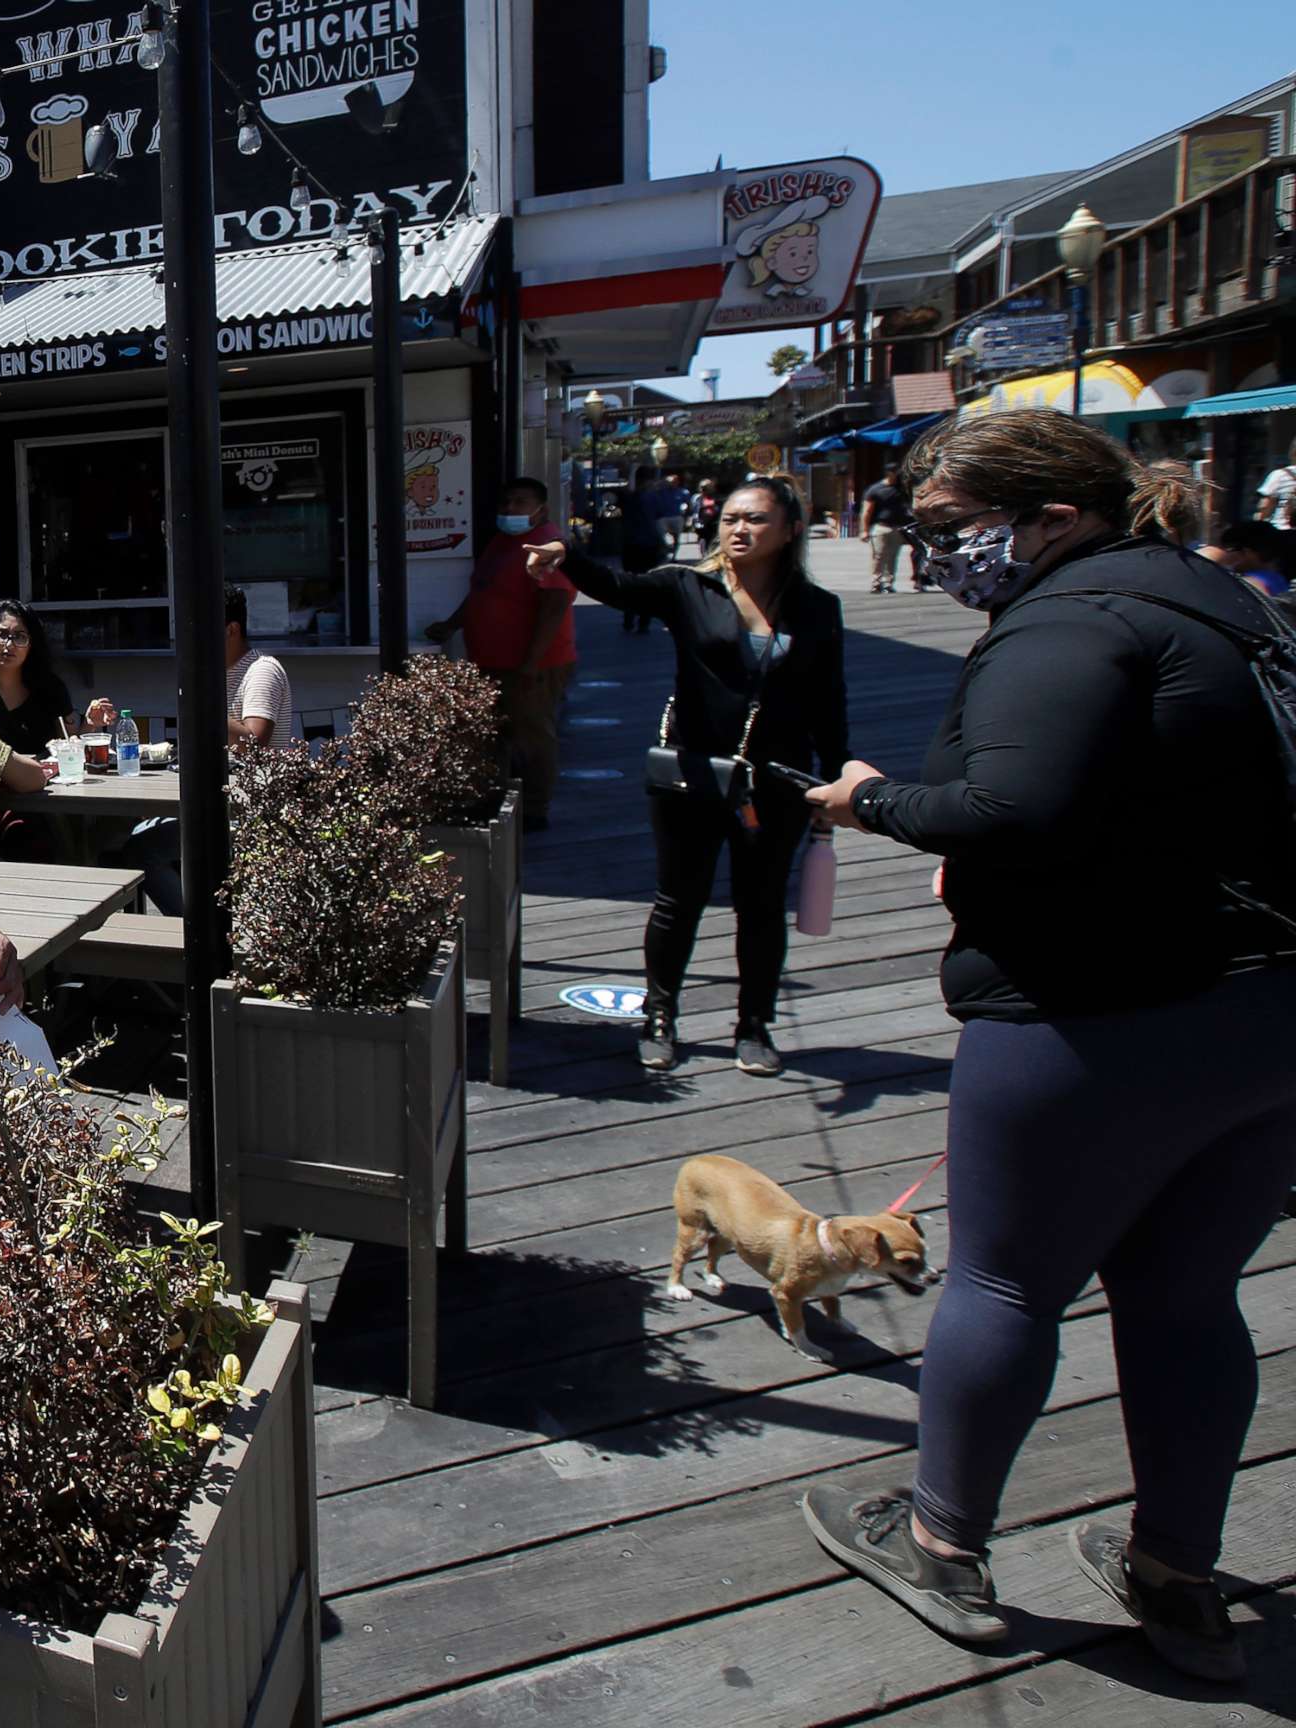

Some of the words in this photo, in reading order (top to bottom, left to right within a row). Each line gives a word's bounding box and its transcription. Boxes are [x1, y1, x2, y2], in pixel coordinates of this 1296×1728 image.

[16, 11, 145, 82] WHA
[255, 0, 419, 59] CHICKEN
[257, 34, 420, 96] SANDWICHES
[215, 180, 453, 249] TODAY
[725, 170, 856, 220] TRISH'S
[258, 311, 373, 350] SANDWIC
[30, 342, 107, 374] STRIPS
[243, 446, 270, 459] Mini
[271, 444, 314, 456] Donuts
[403, 429, 465, 457] ISH'S
